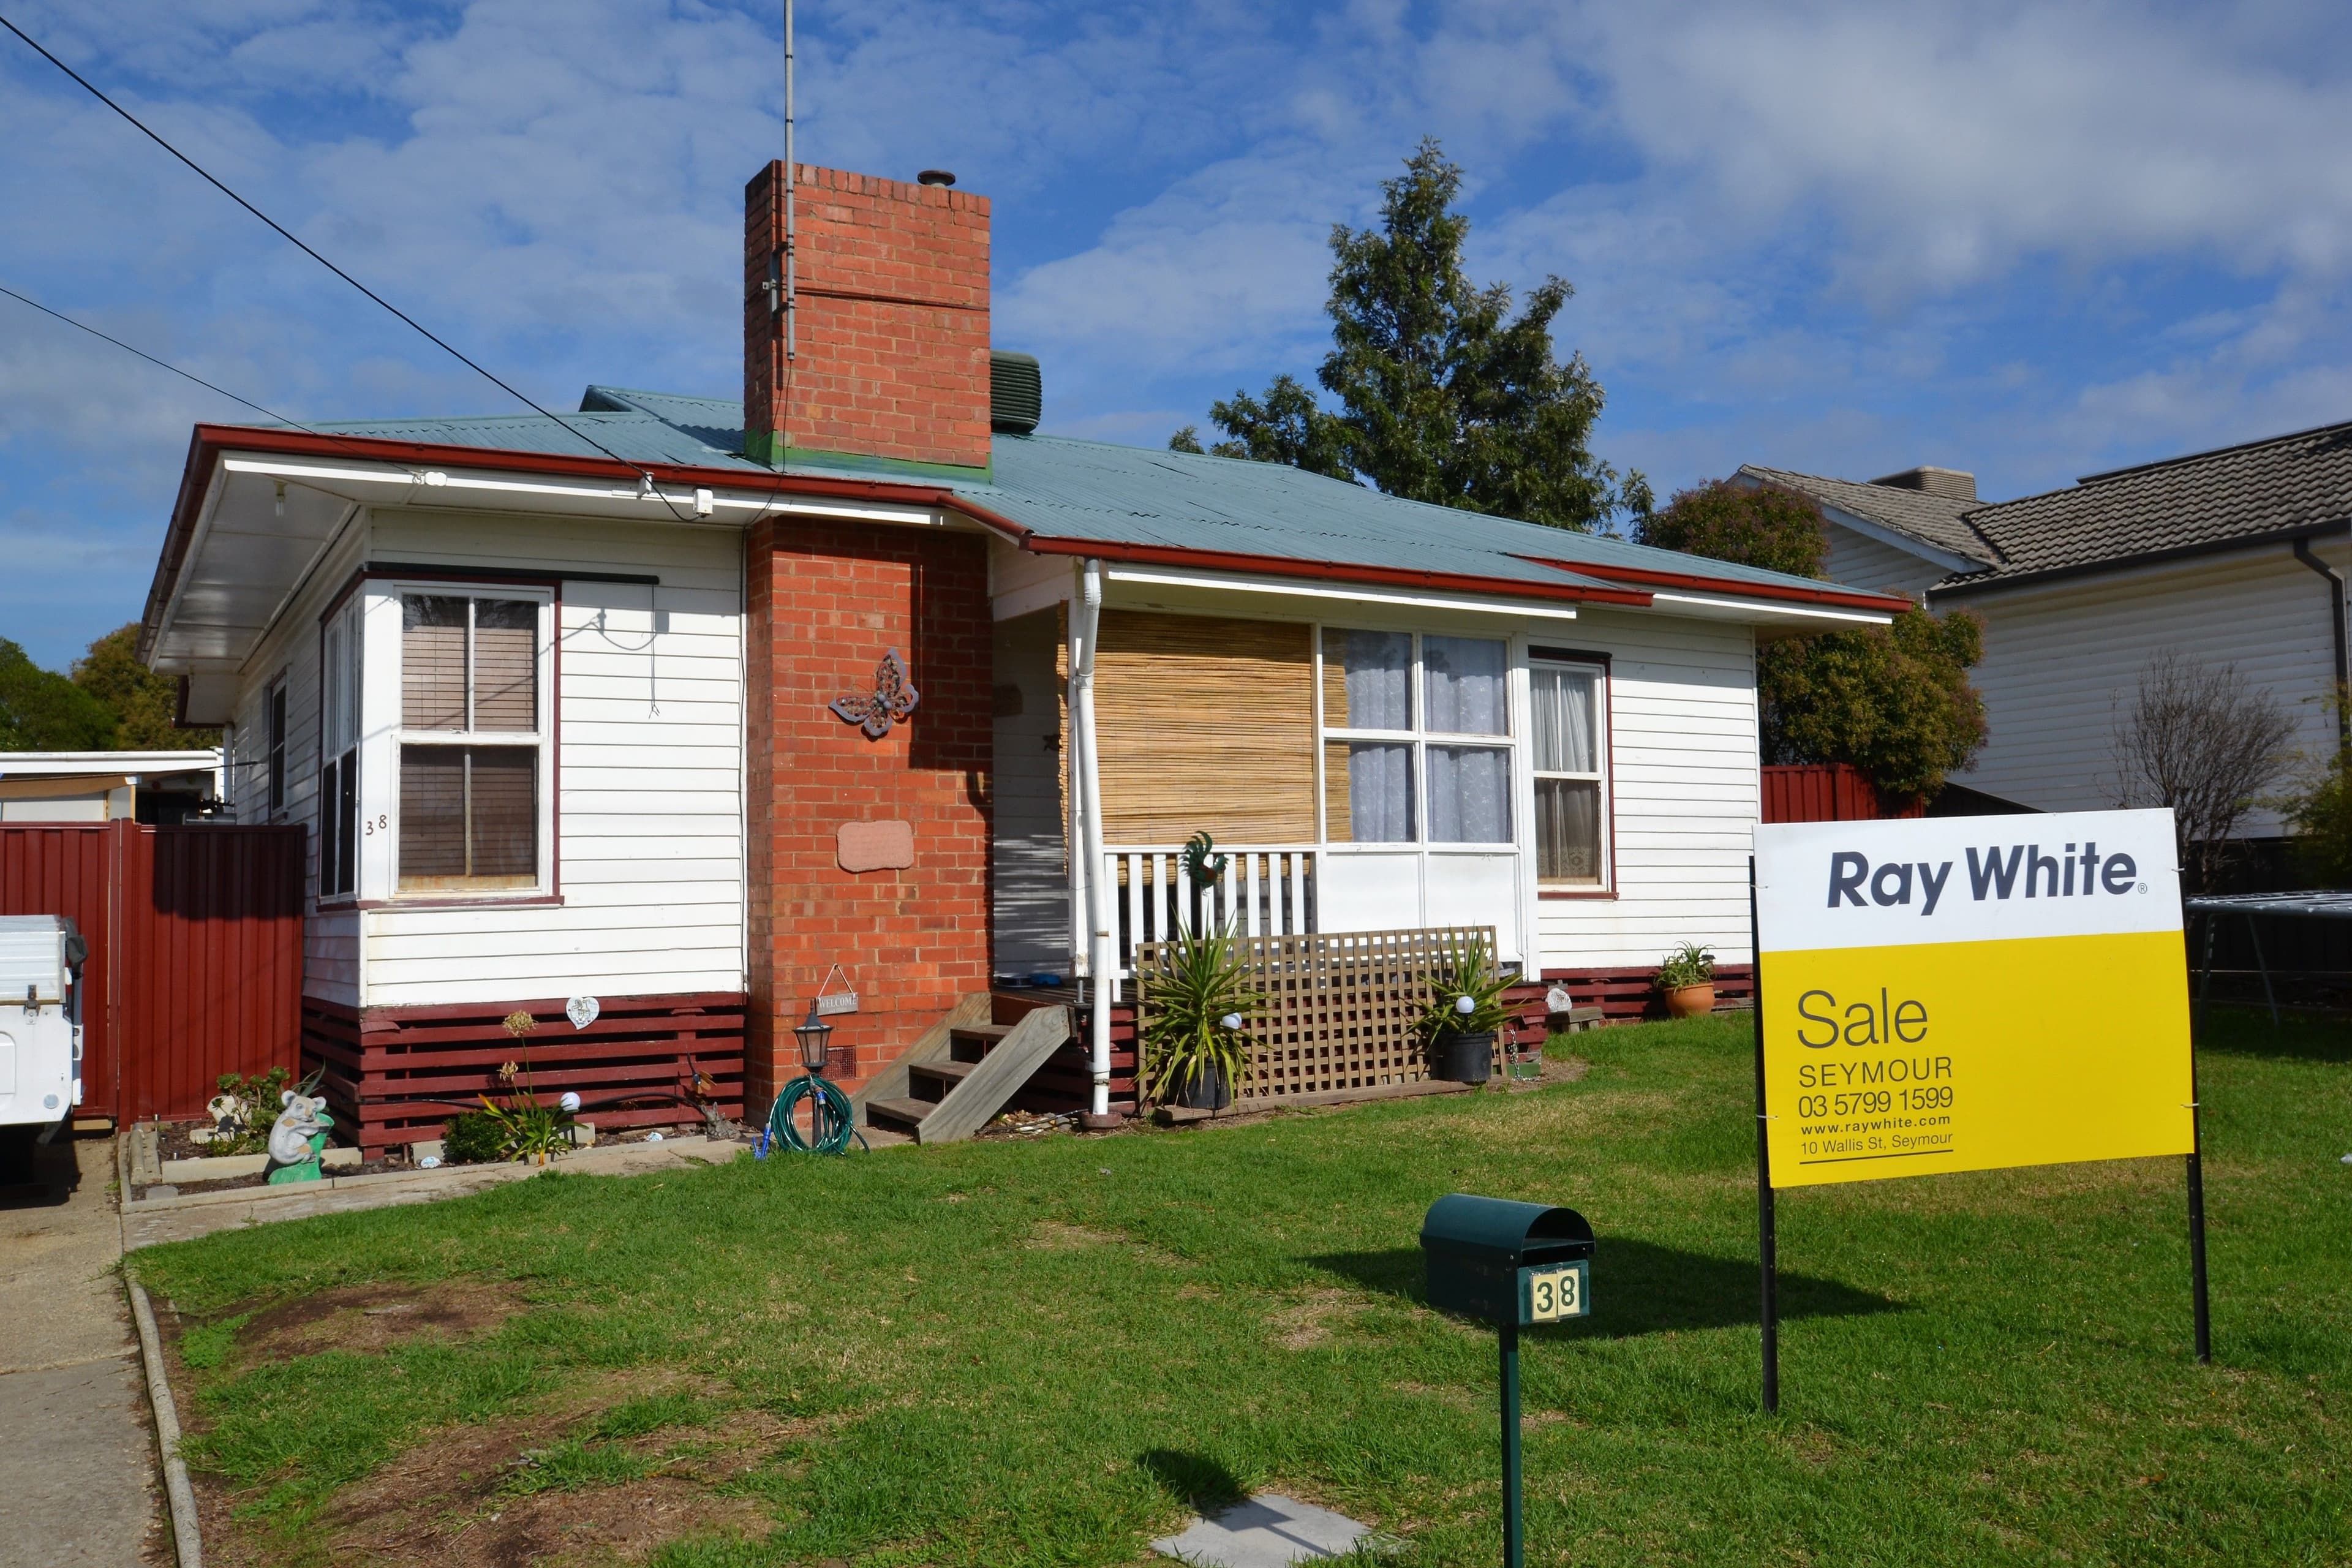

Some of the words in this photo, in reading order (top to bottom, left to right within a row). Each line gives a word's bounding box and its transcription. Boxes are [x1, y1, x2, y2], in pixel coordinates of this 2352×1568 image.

[366, 815, 386, 835] 38
[1827, 851, 1954, 916] Ray
[818, 997, 856, 1008] WELCOME
[1797, 987, 1928, 1049] Sale
[1799, 1057, 1952, 1088] SEYMOUR
[1798, 1095, 1828, 1118] 03
[1834, 1090, 1891, 1115] 5799
[1899, 1086, 1954, 1111] 1599
[1801, 1116, 1950, 1135] www.raywhite.com
[1801, 1142, 1818, 1155] 10
[1822, 1139, 1863, 1153] Wallis
[1868, 1137, 1887, 1150] St,
[1891, 1133, 1954, 1150] Seymour
[1537, 1276, 1575, 1313] 38
